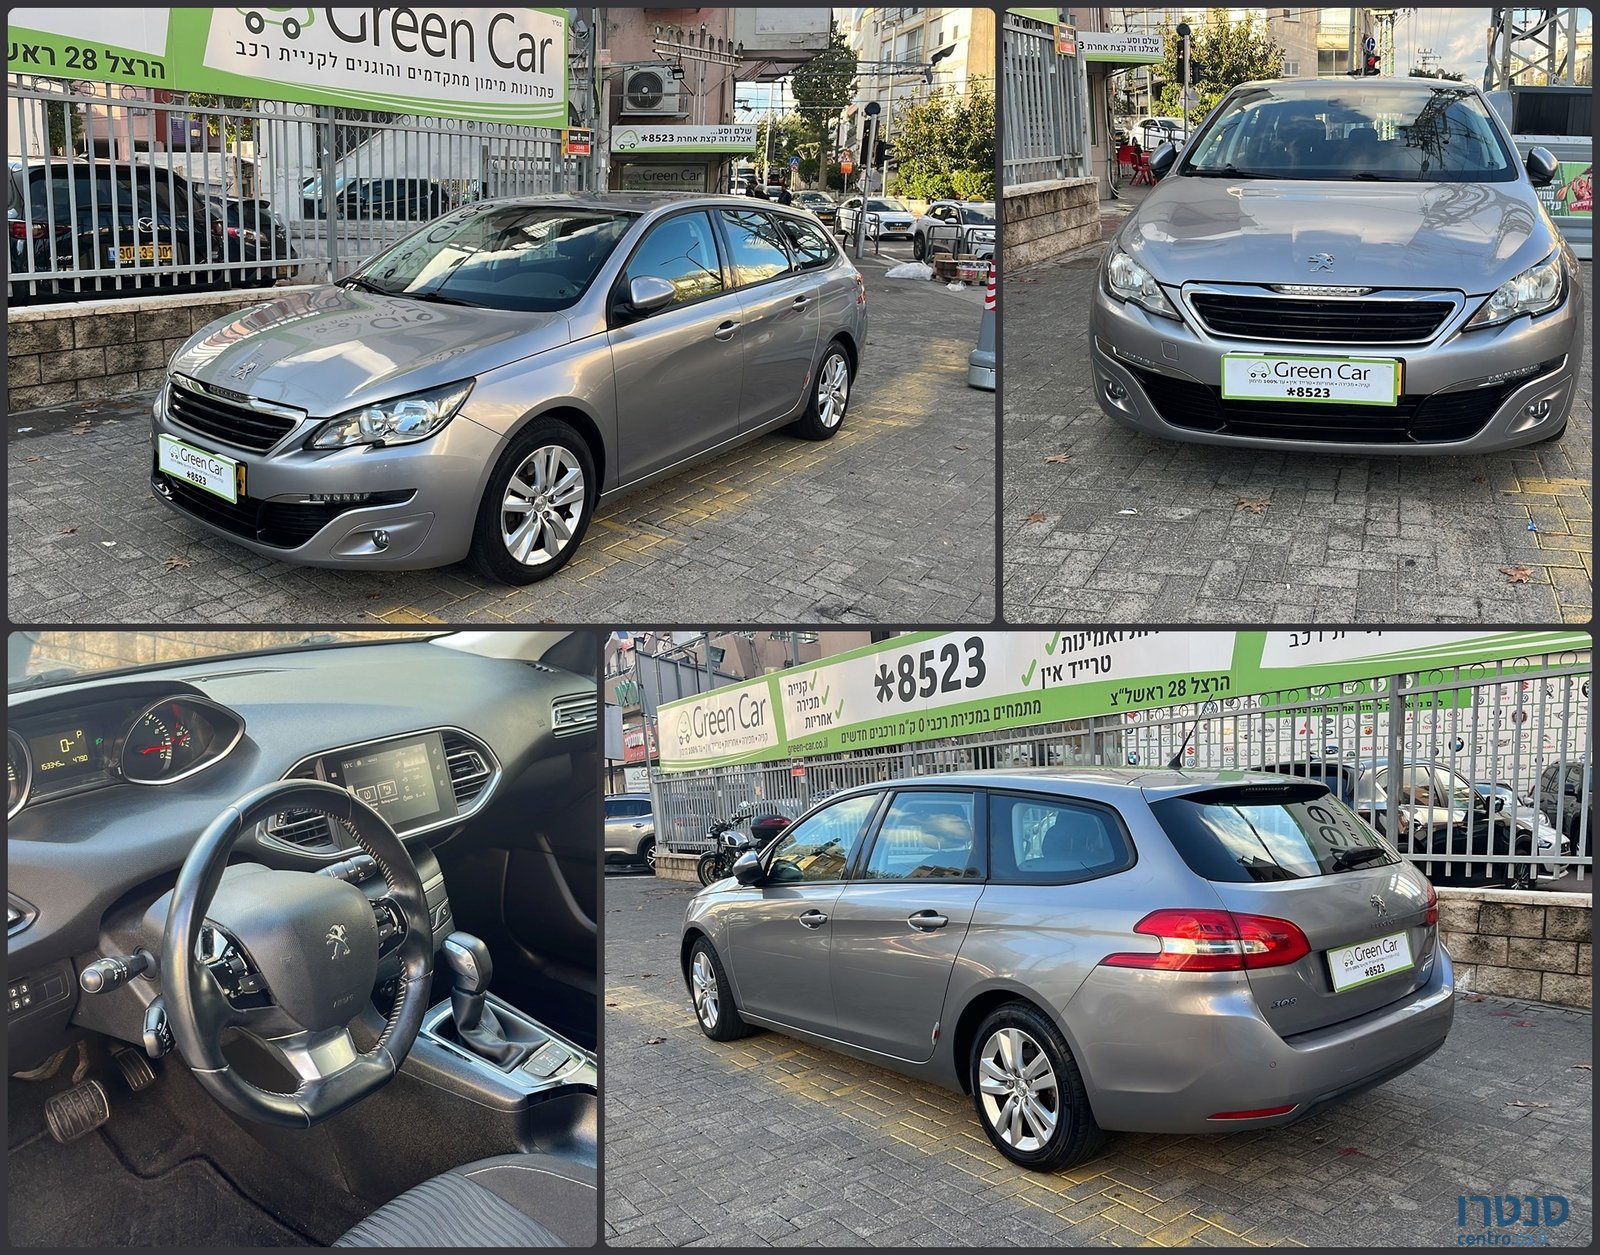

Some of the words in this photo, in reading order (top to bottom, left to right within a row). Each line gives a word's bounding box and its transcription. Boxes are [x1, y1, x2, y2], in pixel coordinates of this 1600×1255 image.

[235, 40, 270, 59] רכב
[325, 8, 475, 63] Green
[487, 12, 553, 74] Car
[1087, 43, 1108, 51] אחרת
[1109, 44, 1126, 53] קצת
[1128, 44, 1137, 52] זה
[1139, 45, 1160, 53] אצלנו
[1142, 37, 1159, 45] שלם
[65, 45, 98, 71] 28
[105, 50, 166, 80] הרצל
[278, 47, 338, 70] לקניית
[346, 57, 400, 78] והוגנים
[407, 66, 470, 87] מתקדמים
[475, 76, 506, 92] מימון
[510, 81, 554, 99] פתרונות
[699, 136, 717, 144] קצת
[729, 135, 752, 143] אצלנו
[734, 127, 752, 135] שלם
[643, 169, 678, 182] Green
[681, 169, 702, 181] Car
[1274, 361, 1332, 380] Green
[1337, 363, 1371, 381] Car
[180, 447, 207, 470] Green
[208, 459, 224, 477] Car
[1068, 654, 1112, 679] טרייד
[1041, 664, 1062, 690] אין
[1191, 675, 1230, 695] הרצל
[788, 680, 808, 697] קנייה
[1168, 679, 1187, 698] 28
[796, 696, 820, 713] מכירה
[993, 699, 1042, 721] מתמחים
[693, 705, 736, 739] Green
[738, 693, 767, 729] Car
[805, 712, 833, 729] אחריות
[927, 715, 948, 732] רכבי
[950, 708, 991, 728] במכירת
[841, 729, 868, 744] חדשים
[869, 724, 897, 740] ורכבים
[787, 736, 829, 756] green-car.co.il
[1354, 944, 1383, 962] Green
[1382, 938, 1398, 954] Car
